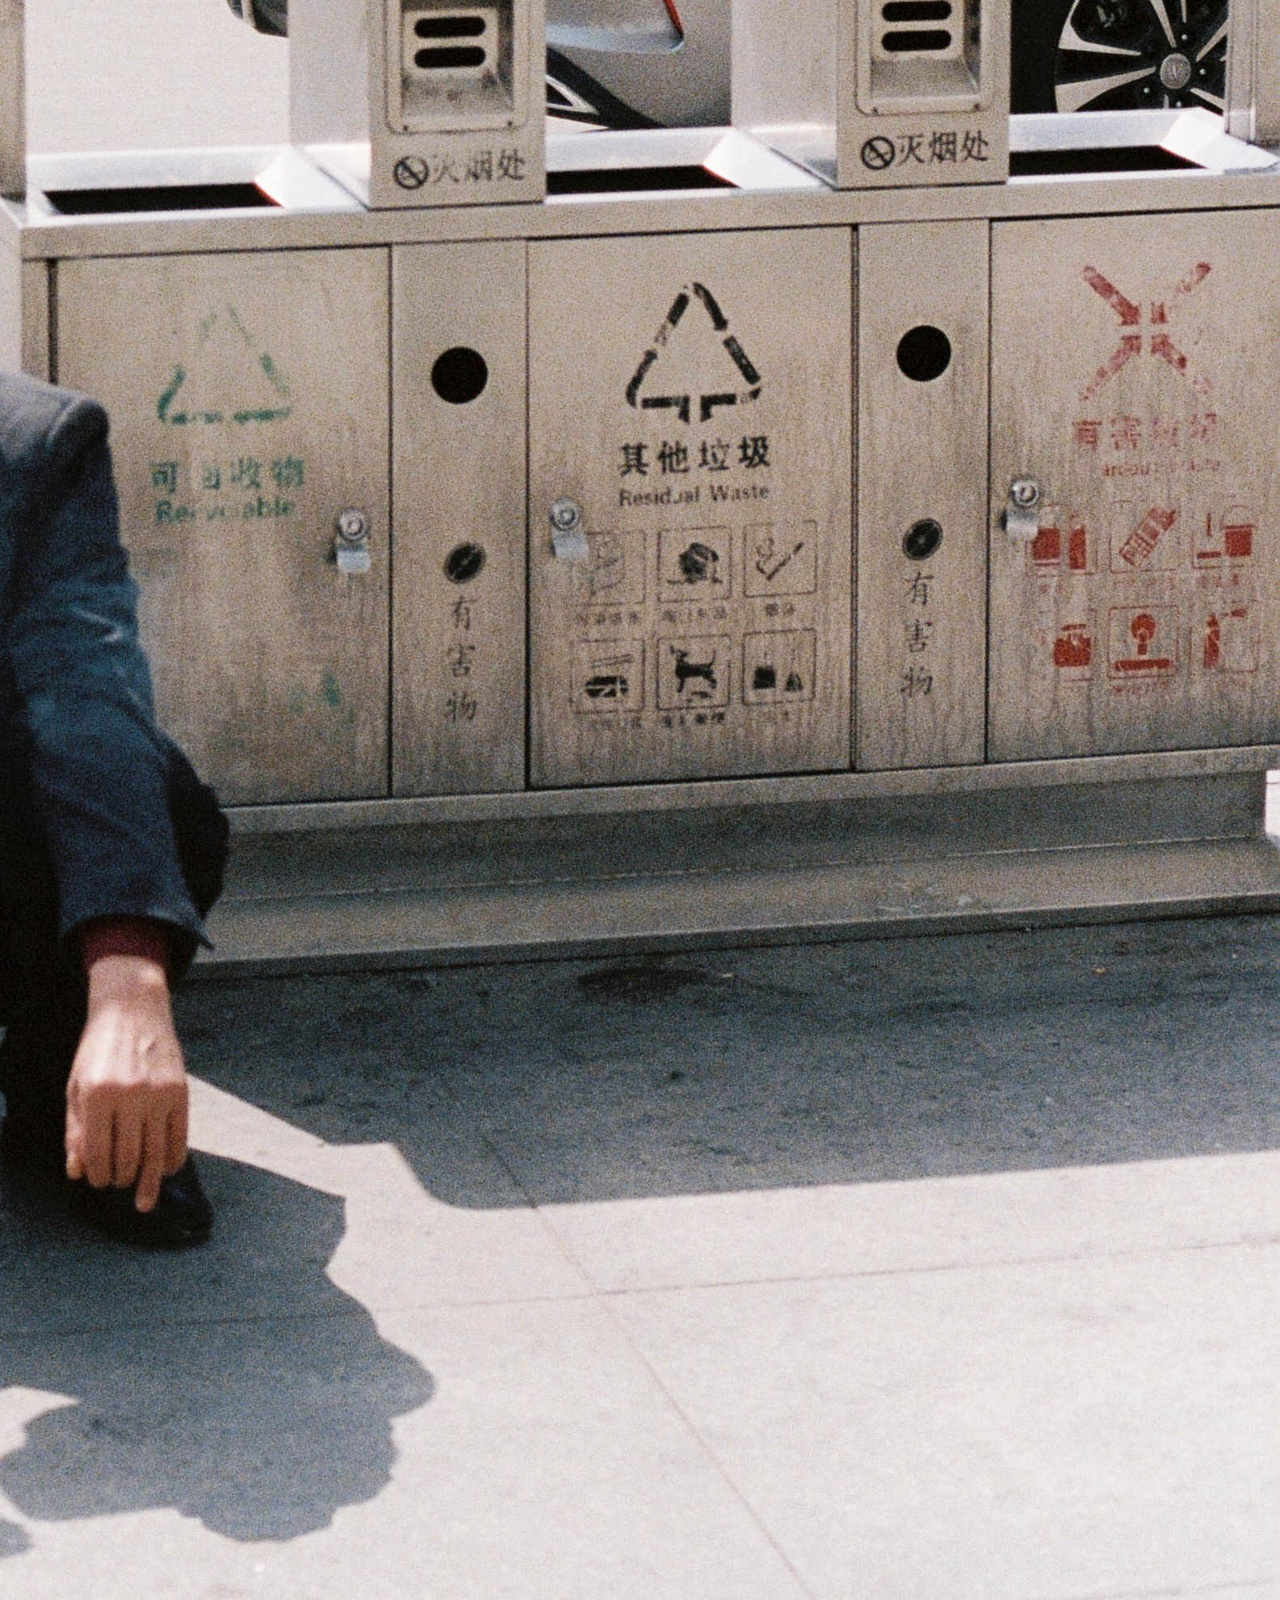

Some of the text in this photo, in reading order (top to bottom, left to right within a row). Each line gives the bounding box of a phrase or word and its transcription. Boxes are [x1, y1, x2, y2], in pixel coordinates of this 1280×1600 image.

[429, 148, 527, 184] 灭烟处
[895, 130, 991, 166] 灭烟处
[618, 435, 771, 477] 其他垃圾
[709, 483, 770, 503] Waste
[898, 570, 935, 699] 有害物
[442, 594, 480, 724] 有害物
